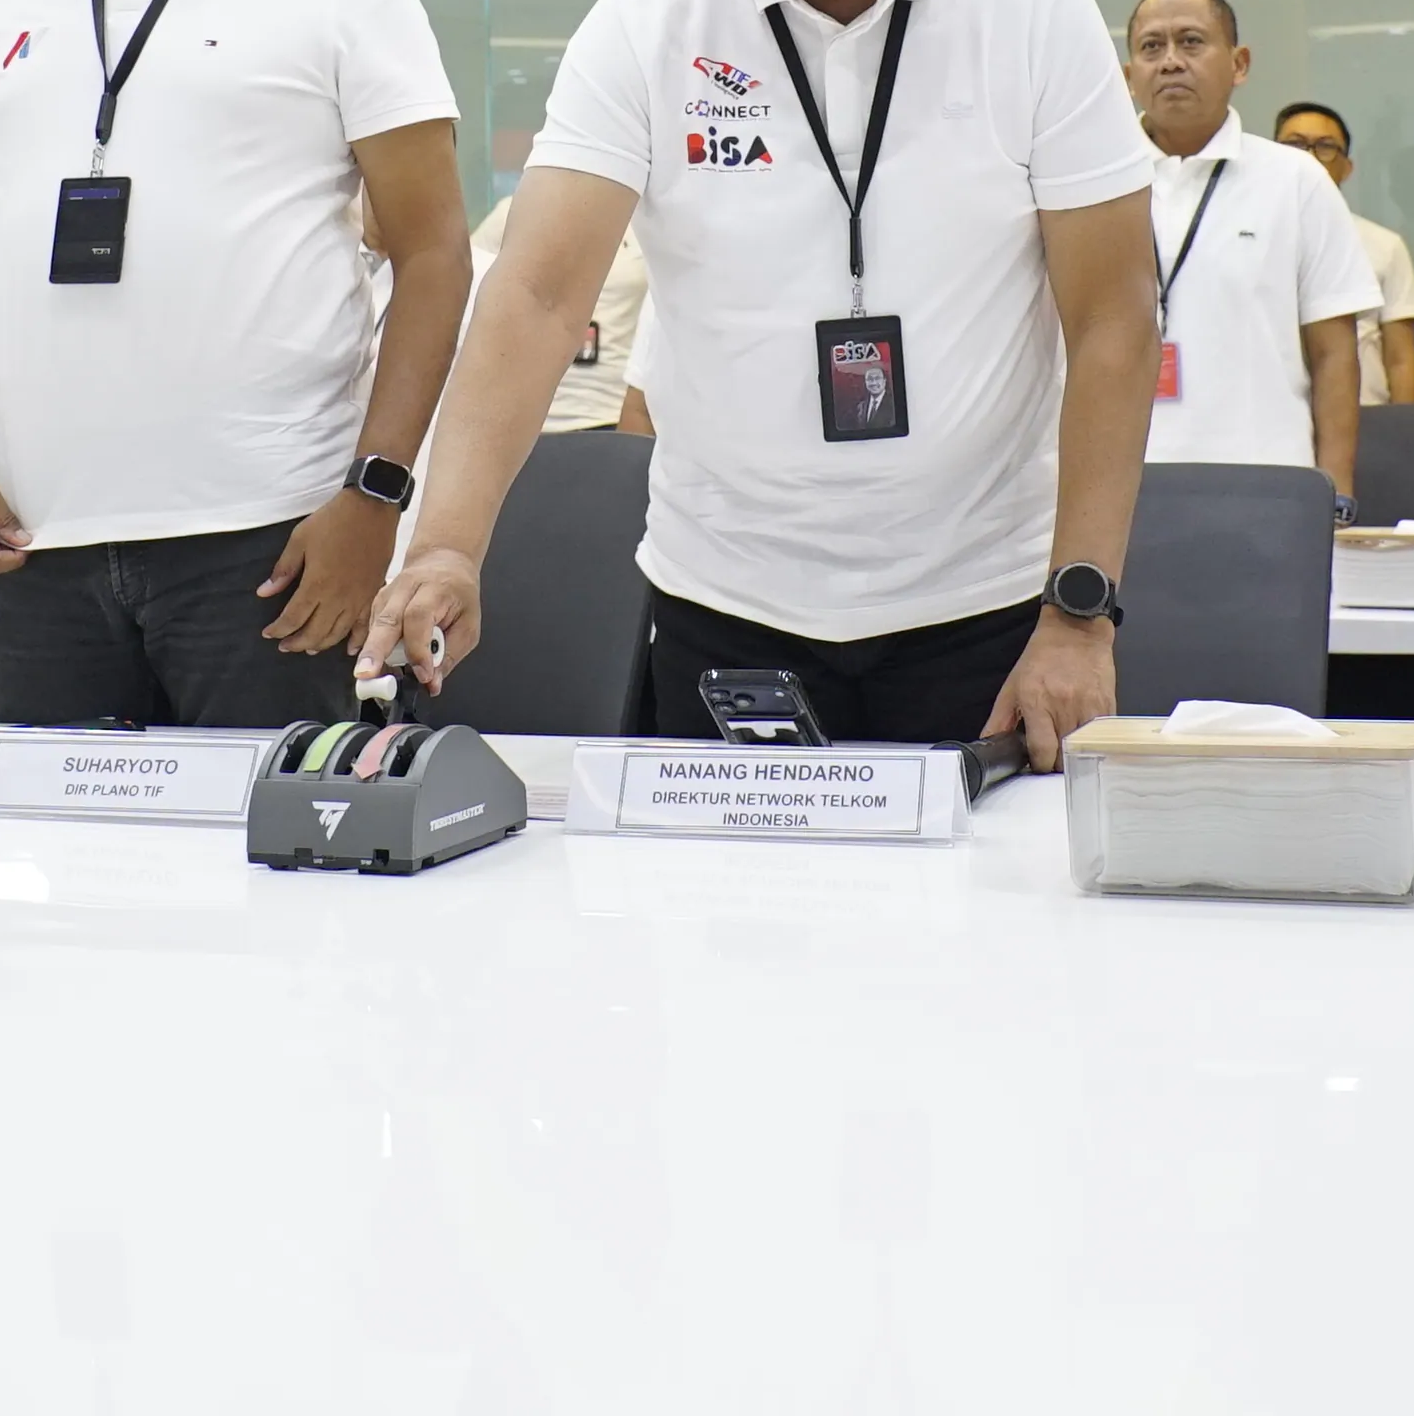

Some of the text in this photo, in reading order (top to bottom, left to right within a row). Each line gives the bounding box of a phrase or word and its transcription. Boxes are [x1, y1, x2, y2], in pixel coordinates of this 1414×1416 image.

[685, 100, 771, 118] CONNECT
[62, 756, 179, 775] SUHARYOTO
[659, 762, 874, 782] NANANG HENDARNO
[64, 783, 165, 798] DIR PLANO TIF
[652, 791, 887, 808] DIREKTUR NETWORK TELKOM
[722, 812, 809, 827] INDONESIA
